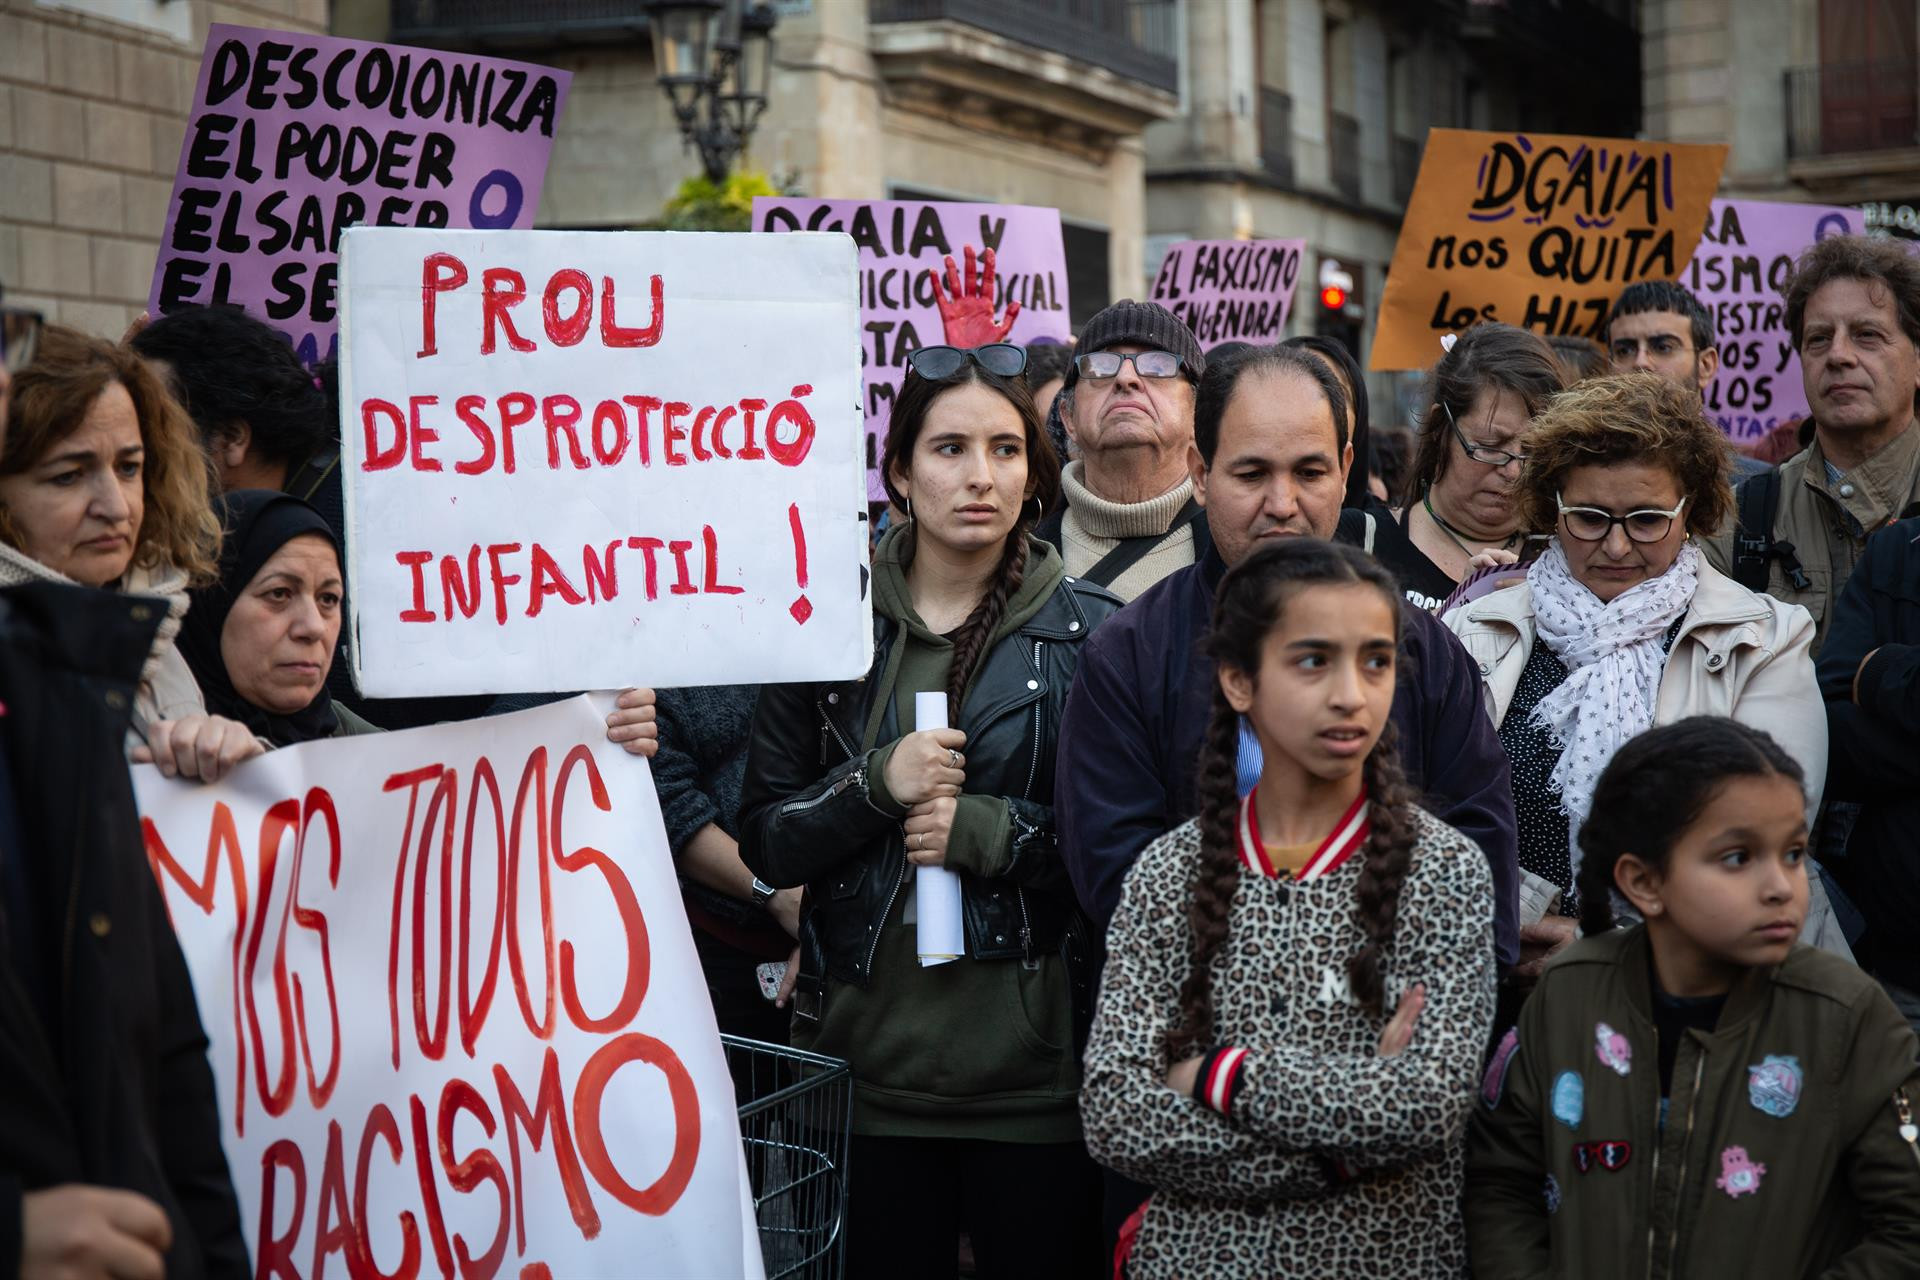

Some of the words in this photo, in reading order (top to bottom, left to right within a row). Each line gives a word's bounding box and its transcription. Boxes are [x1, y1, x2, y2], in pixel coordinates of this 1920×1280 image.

[205, 39, 558, 138] DESCOLONIZA
[187, 113, 262, 182] EL
[275, 121, 456, 190] PODER
[1472, 142, 1658, 226] DGAIA
[172, 187, 250, 253] EL
[1528, 226, 1675, 285] QUITA
[417, 251, 665, 358] PROU
[1155, 249, 1182, 299] EL
[361, 383, 816, 475] DESPROTECCIÓ
[395, 524, 746, 626] INFANTIL
[382, 743, 651, 1073] TODOS
[254, 1032, 701, 1280] RACISMO
